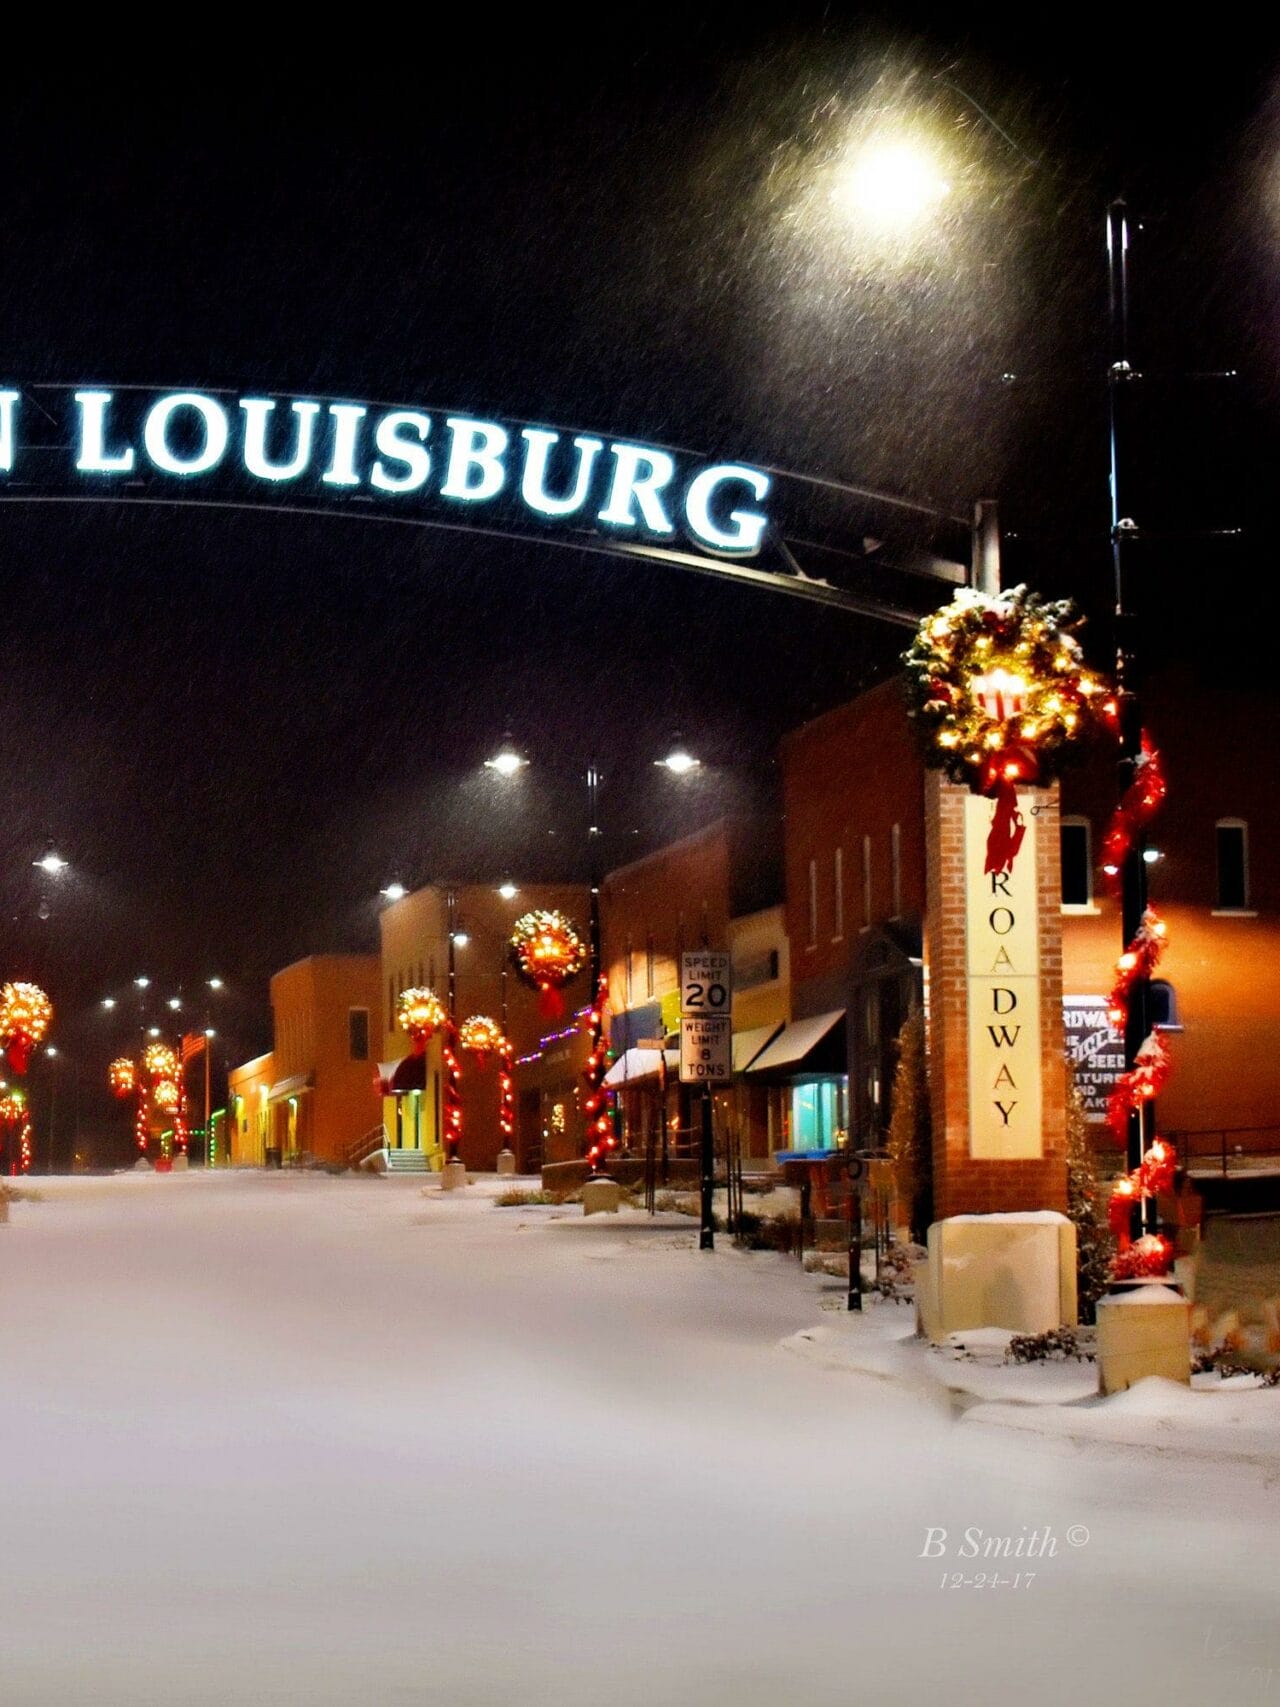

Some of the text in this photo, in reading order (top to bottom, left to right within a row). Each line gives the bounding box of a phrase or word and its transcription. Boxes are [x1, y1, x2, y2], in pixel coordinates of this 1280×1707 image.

[73, 391, 771, 551] LOUISBURG
[684, 957, 727, 968] SPEED
[688, 970, 722, 981] LIMIT
[685, 983, 727, 1008] 20
[987, 871, 1021, 1128] ROADWAY
[685, 1022, 727, 1033] WEIGHT
[691, 1034, 719, 1045] LIMIT
[701, 1048, 711, 1060] 8
[687, 1063, 725, 1076] TONS
